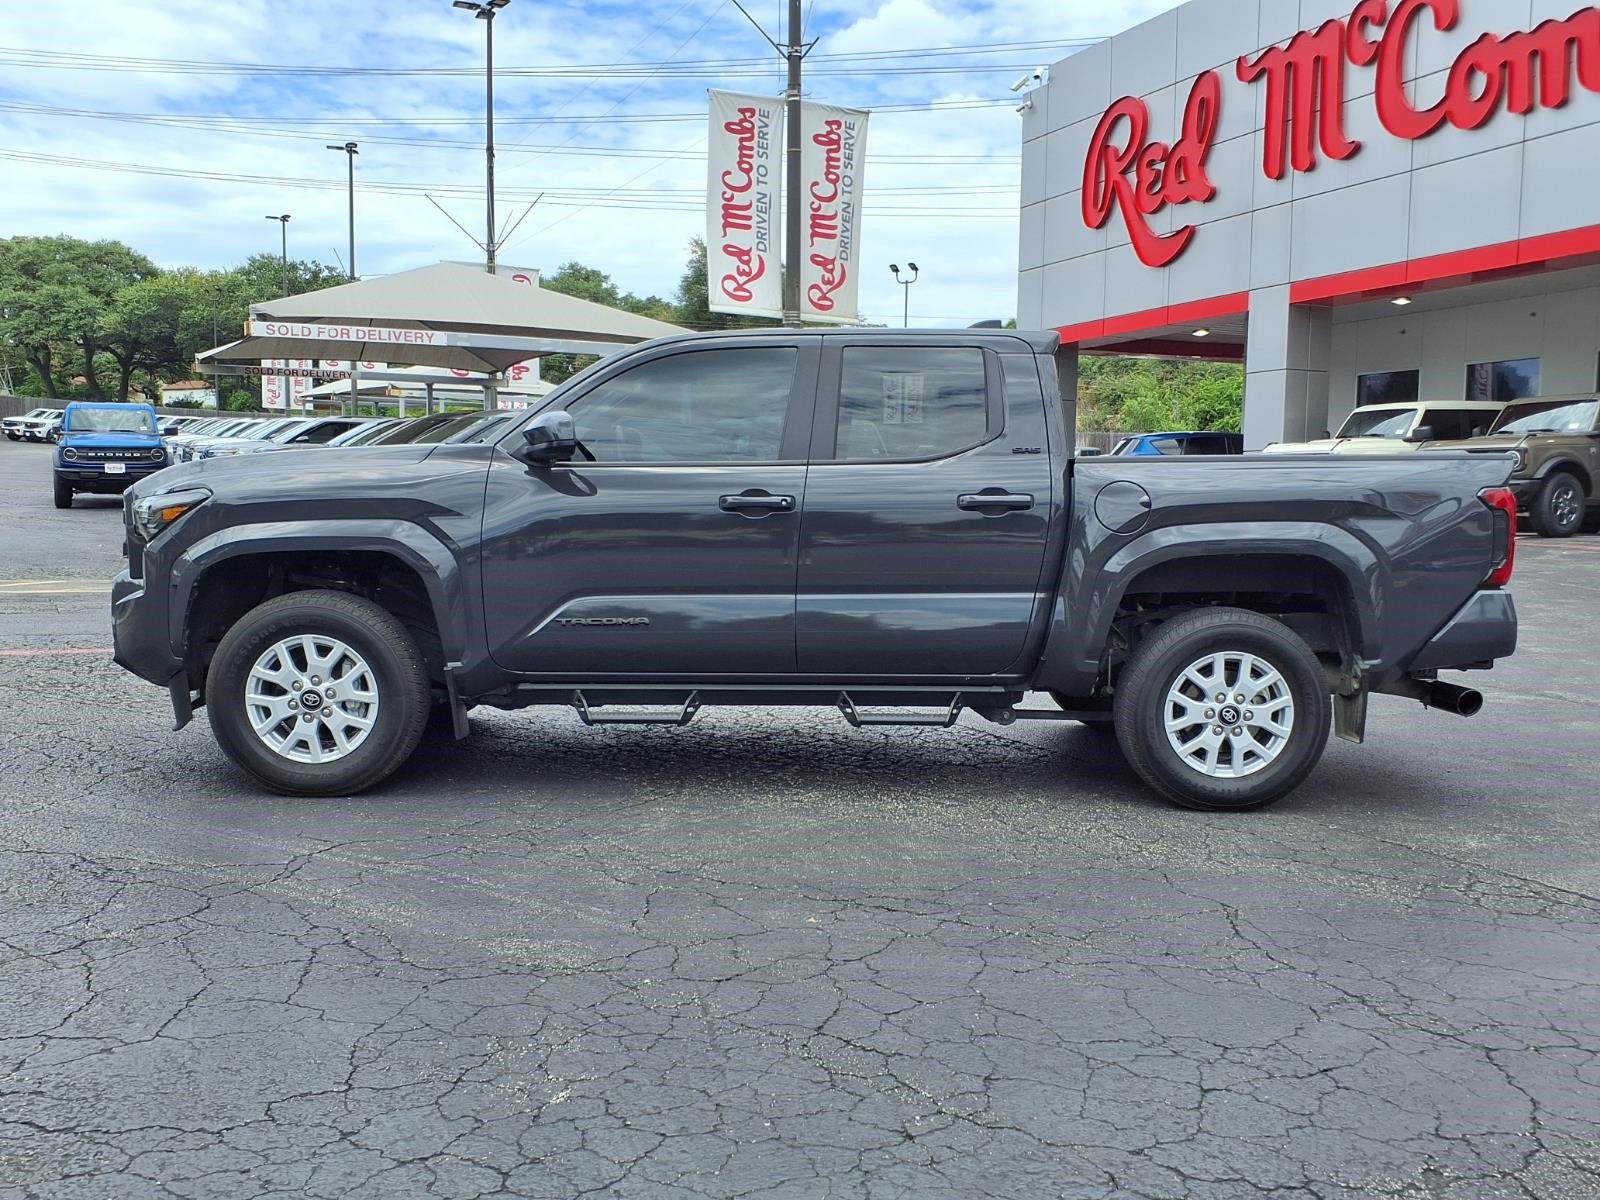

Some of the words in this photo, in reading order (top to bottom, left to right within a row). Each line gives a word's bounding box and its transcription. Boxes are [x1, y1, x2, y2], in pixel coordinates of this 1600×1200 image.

[757, 108, 770, 160] SERVE
[842, 120, 855, 171] SERVE
[721, 106, 757, 239] McCombs
[756, 164, 769, 187] TO
[809, 119, 843, 248] McCombs
[842, 174, 853, 196] TO
[1082, 70, 1221, 268] Red
[756, 192, 768, 254] DRIVEN
[840, 201, 851, 262] DRIVEN
[721, 243, 765, 303] Red
[807, 253, 847, 312] Red
[265, 323, 312, 337] SOLD
[317, 326, 351, 340] FOR
[355, 328, 435, 344] DELIVERY
[244, 366, 274, 376] SOLD
[277, 368, 299, 378] FOR
[301, 369, 353, 380] DELIVERY
[555, 617, 651, 626] TACOMA
